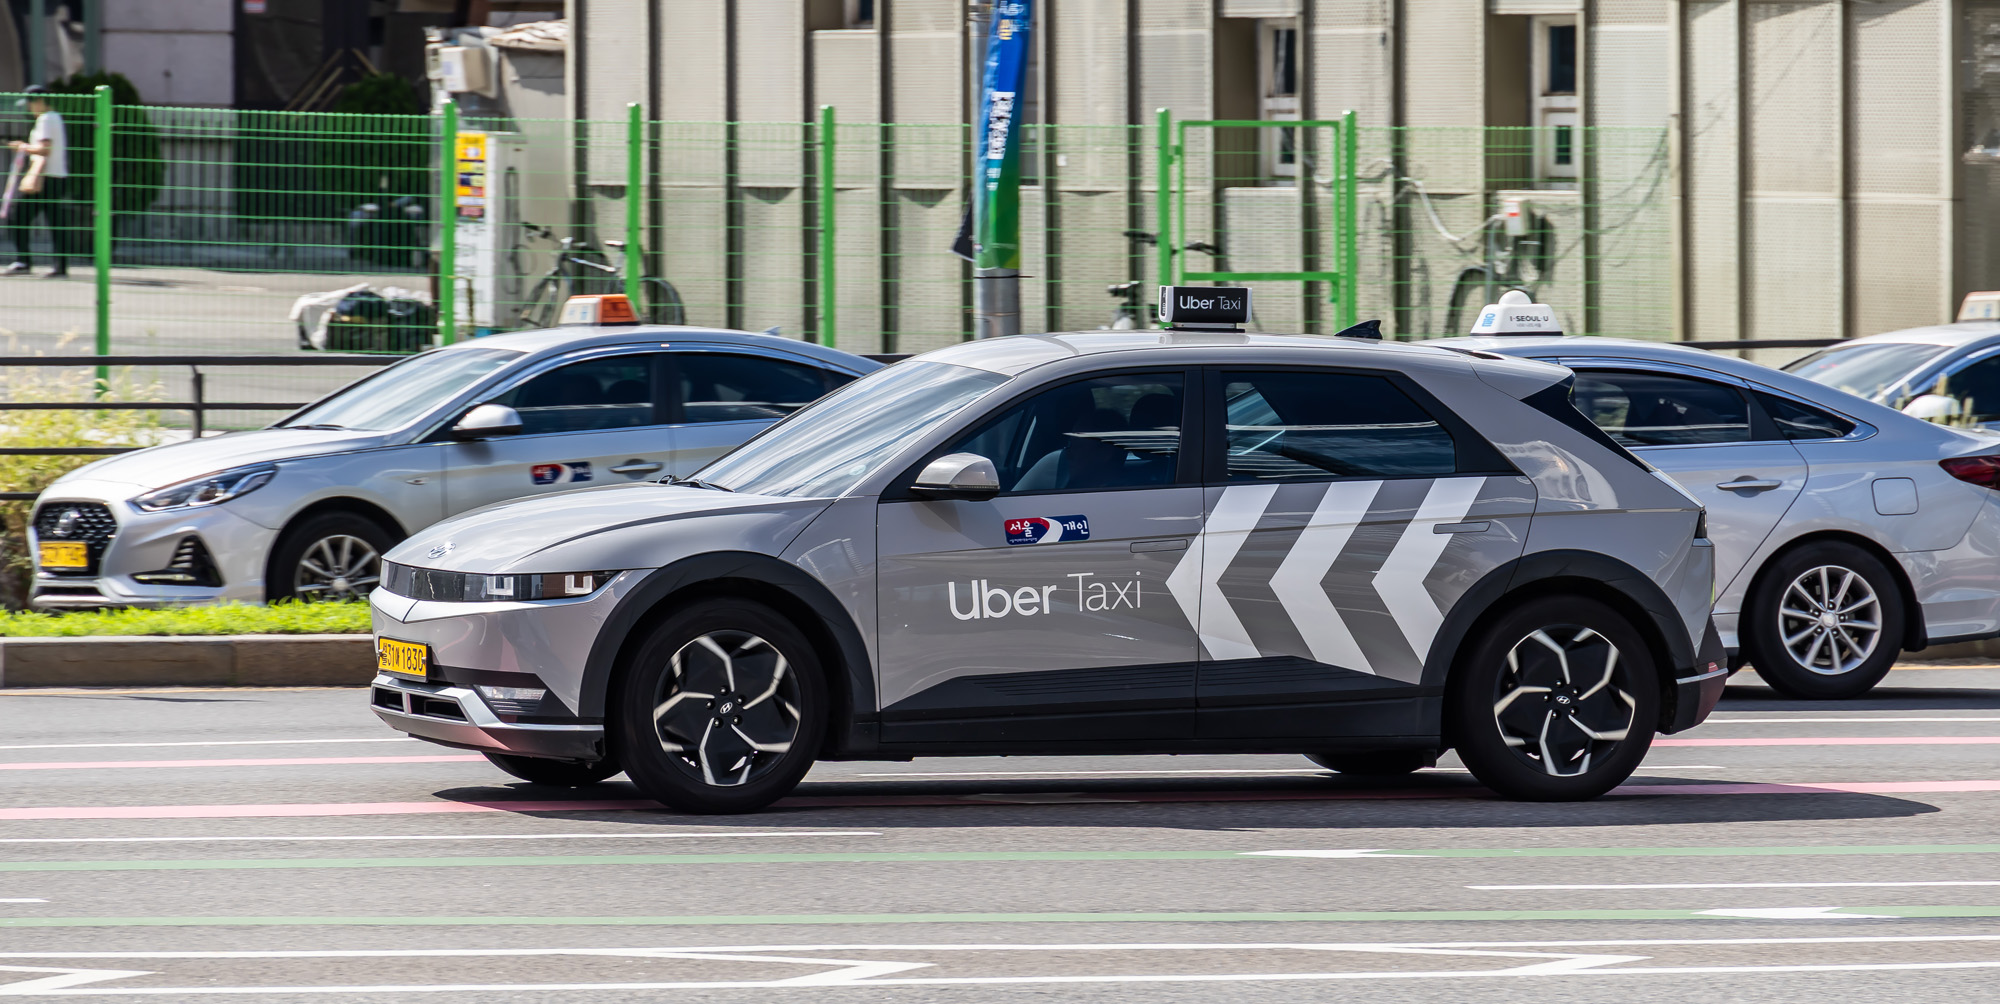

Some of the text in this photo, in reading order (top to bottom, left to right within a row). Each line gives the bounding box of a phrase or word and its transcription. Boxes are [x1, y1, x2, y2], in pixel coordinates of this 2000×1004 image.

[1180, 295, 1214, 310] Uber
[1217, 296, 1241, 310] Taxi
[1010, 520, 1088, 537] 서울 개인
[948, 571, 1141, 620] Uber Taxi
